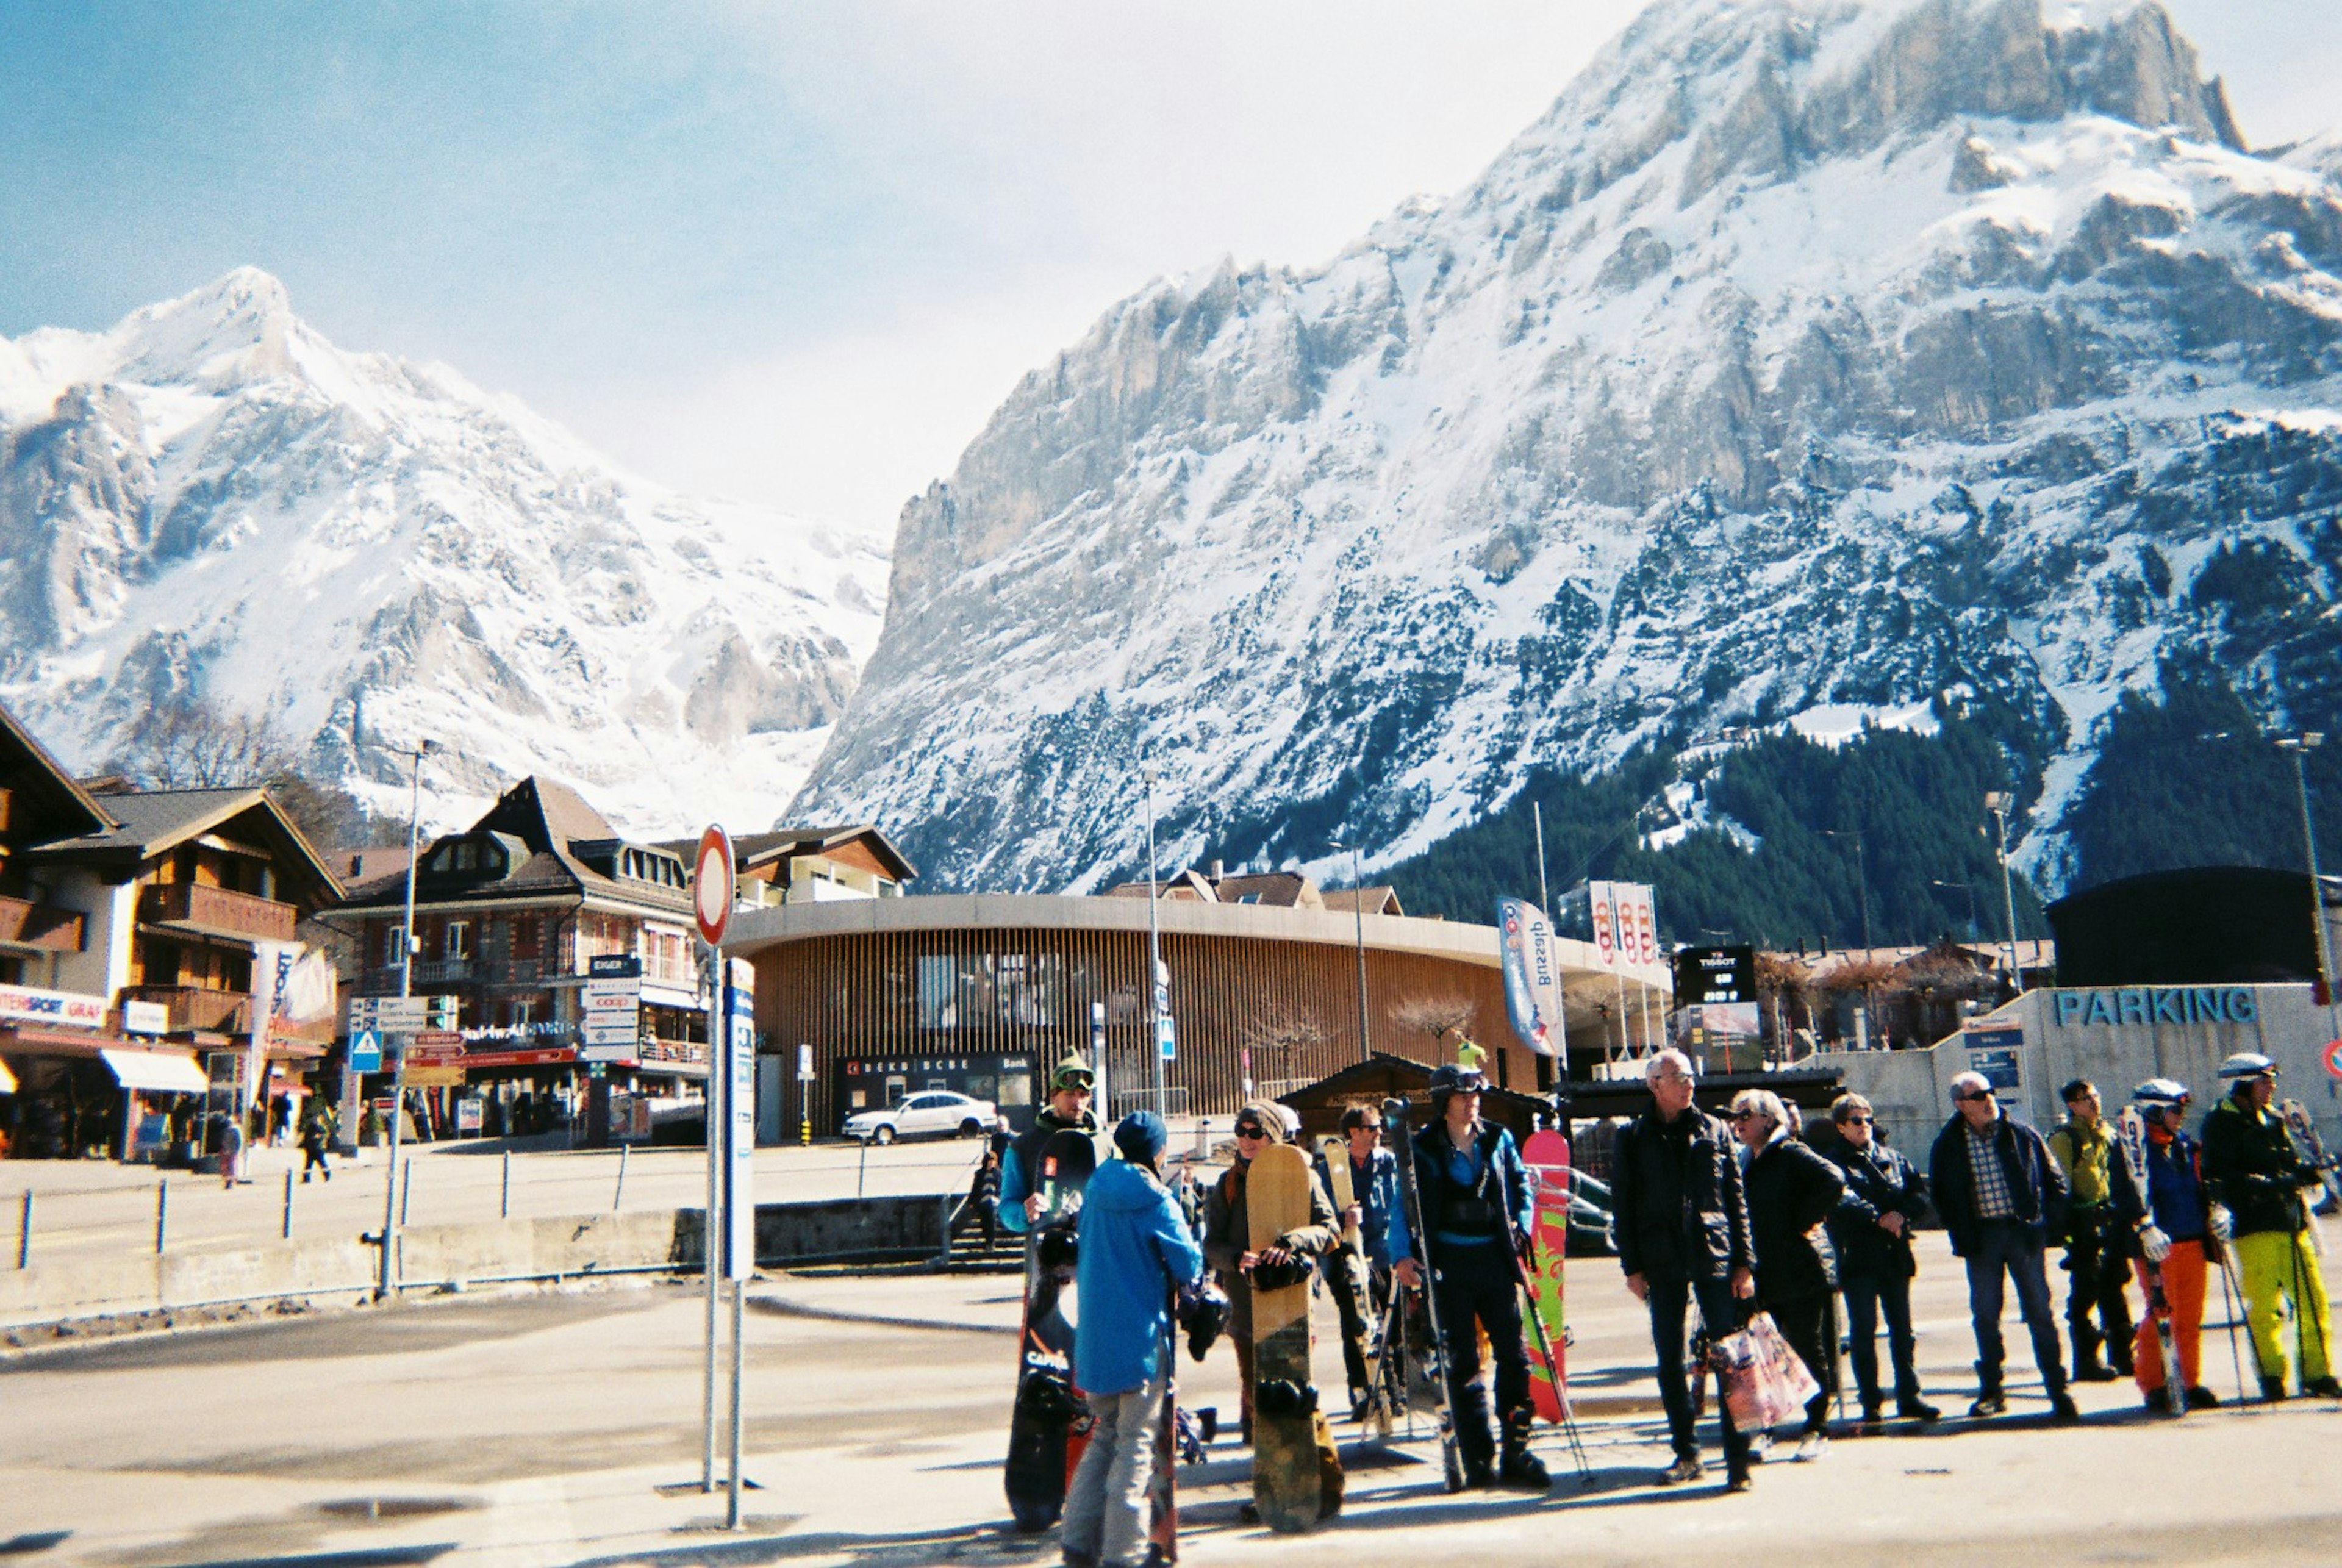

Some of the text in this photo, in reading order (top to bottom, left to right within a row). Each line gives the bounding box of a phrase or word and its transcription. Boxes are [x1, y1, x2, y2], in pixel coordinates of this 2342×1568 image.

[1699, 958, 1736, 967] TISSOT
[68, 1002, 101, 1018] GRAF
[2054, 987, 2257, 1027] PARKING
[1003, 1058, 1028, 1069] Bank
